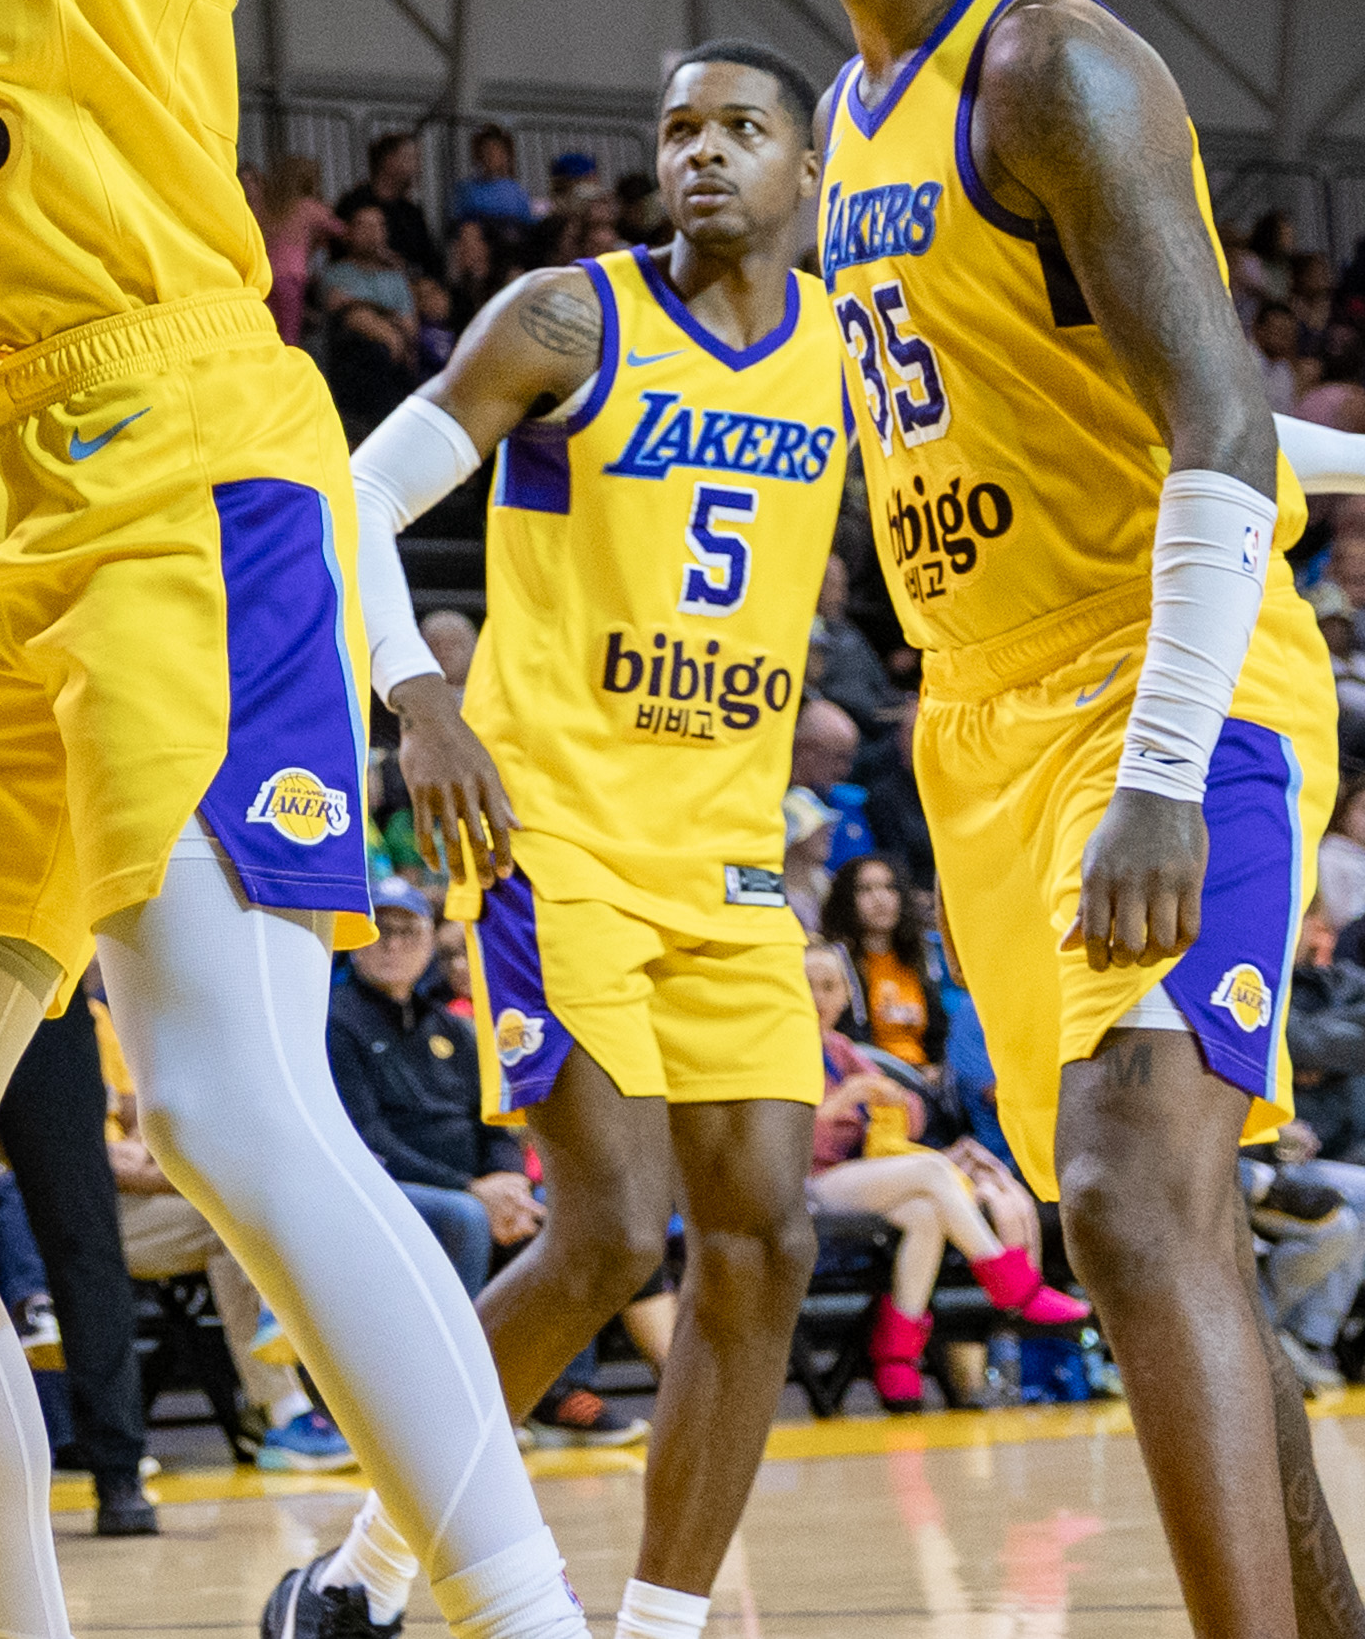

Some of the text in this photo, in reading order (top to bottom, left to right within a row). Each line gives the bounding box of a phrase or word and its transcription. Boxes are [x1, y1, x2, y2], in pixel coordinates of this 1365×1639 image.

[833, 278, 952, 458] 35
[603, 388, 836, 484] LAKERS
[675, 481, 759, 618] 5
[602, 632, 792, 730] bibigo
[635, 704, 717, 741] 비비고
[254, 784, 347, 832] LAKERS
